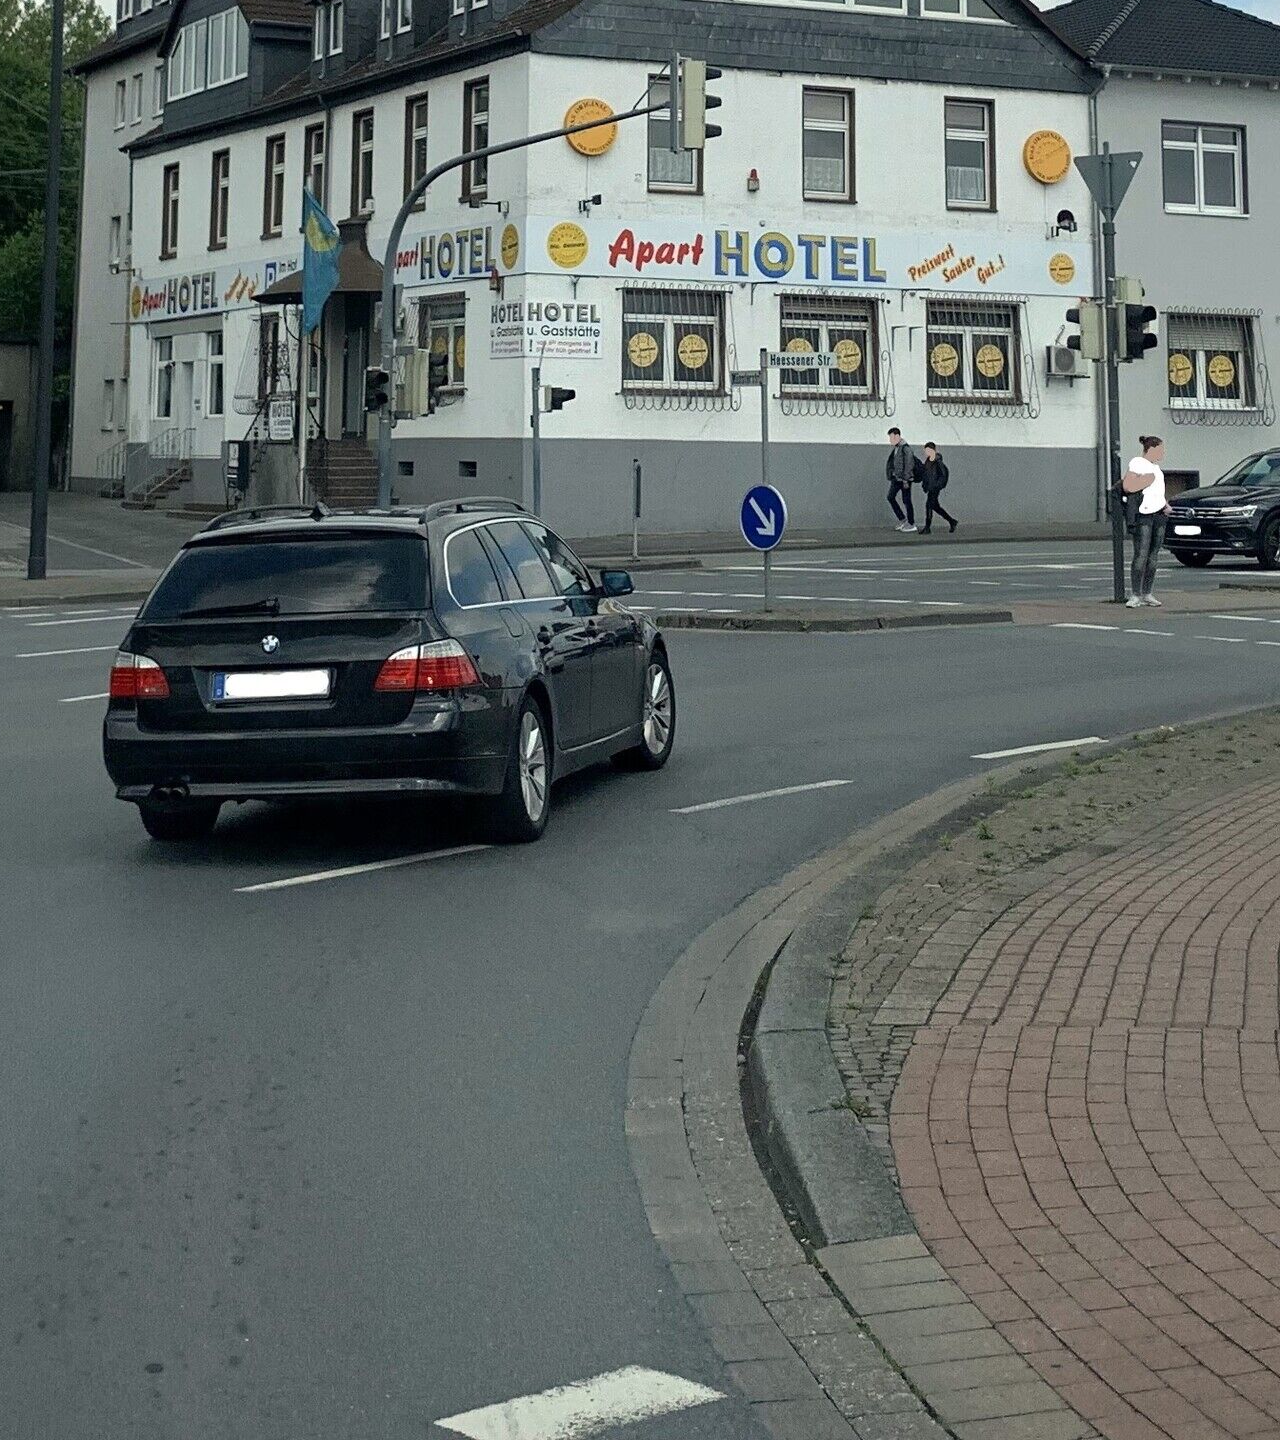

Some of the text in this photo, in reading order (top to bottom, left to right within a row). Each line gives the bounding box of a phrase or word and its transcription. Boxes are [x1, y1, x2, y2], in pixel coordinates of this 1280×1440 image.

[395, 226, 497, 280] part HOTEL
[608, 228, 887, 283] Apart HOTEL
[907, 243, 955, 283] Preiswert
[941, 255, 976, 283] Sauber
[167, 271, 218, 315] HOTEL
[491, 302, 524, 324] HOTEL
[528, 302, 601, 324] HOTEL
[541, 324, 601, 338] Gaststätte
